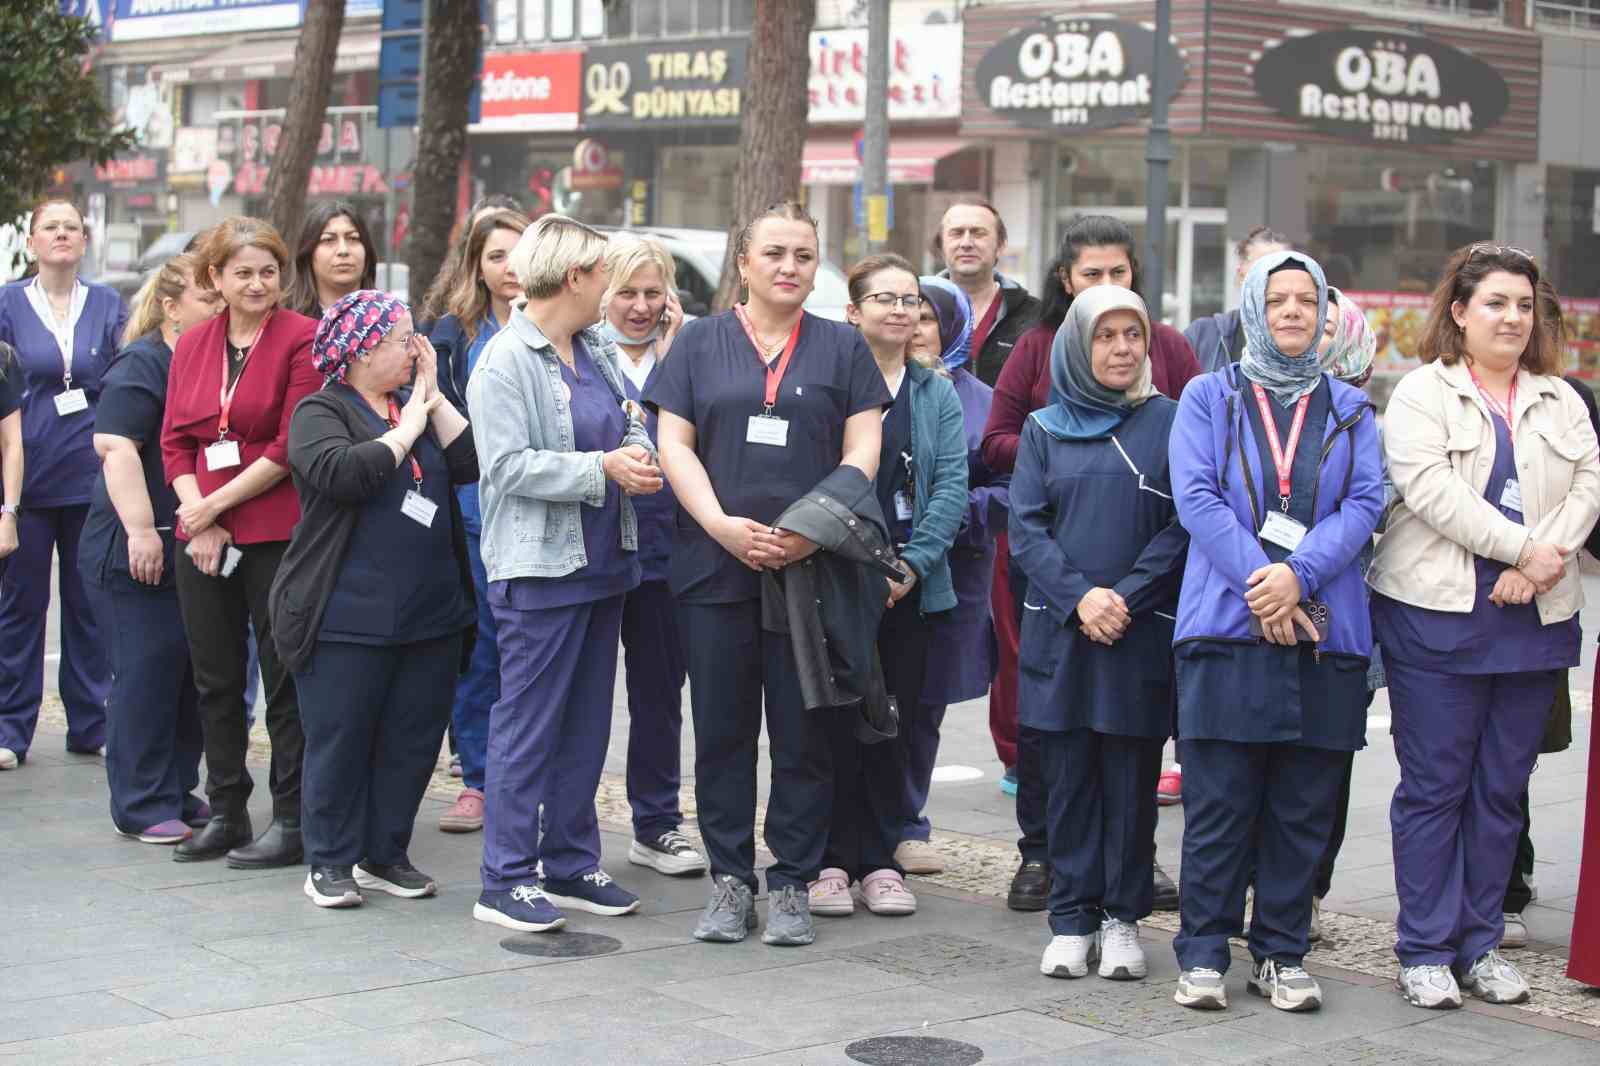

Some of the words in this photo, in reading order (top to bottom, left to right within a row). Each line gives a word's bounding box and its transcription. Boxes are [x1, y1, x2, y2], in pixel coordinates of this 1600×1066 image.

[647, 50, 727, 82] TIRAŞ
[1018, 31, 1124, 78] OBA
[481, 70, 551, 102] dafone
[1335, 46, 1441, 99] OBA
[633, 88, 740, 117] DÜNYASI
[990, 74, 1151, 108] Restaurant
[1300, 84, 1473, 131] Restaurant
